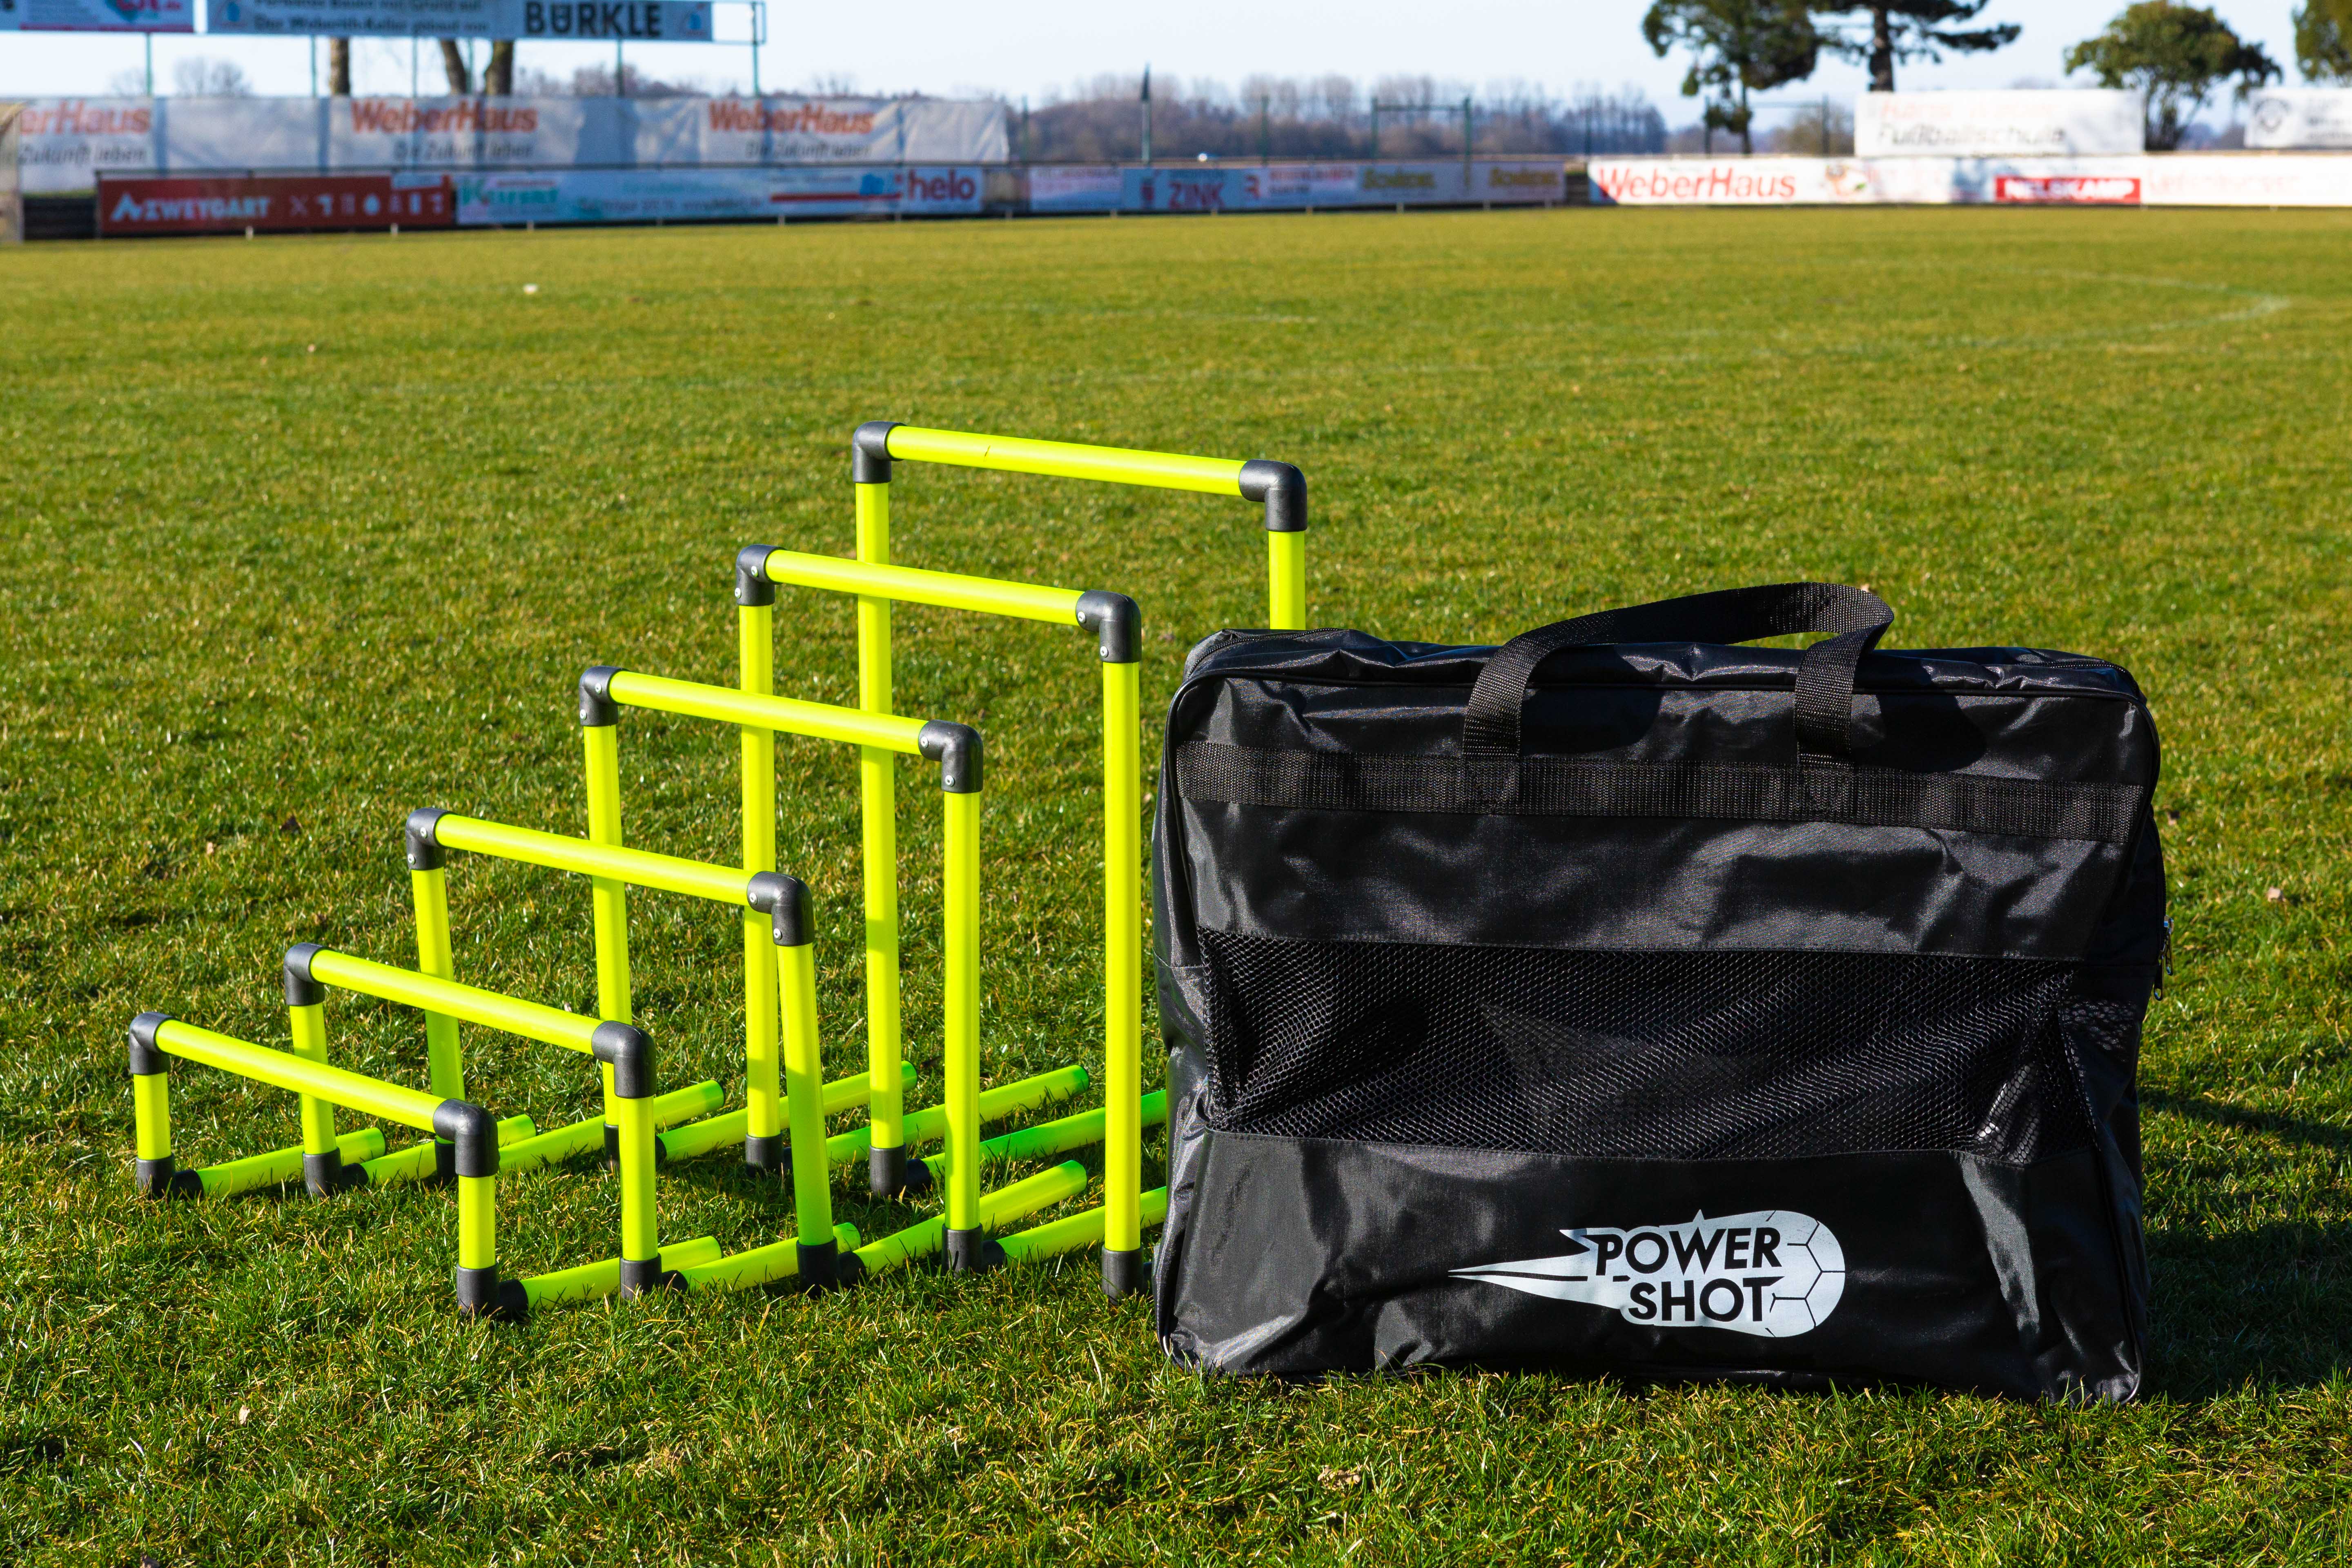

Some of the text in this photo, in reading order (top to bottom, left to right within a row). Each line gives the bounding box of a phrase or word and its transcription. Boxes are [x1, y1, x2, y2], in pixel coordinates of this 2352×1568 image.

[526, 1, 662, 36] BÜRKLE
[351, 99, 538, 134] WeberHaus
[708, 100, 874, 134] WeberHaus
[1167, 182, 1224, 209] ZINK
[1597, 167, 1797, 199] WeberHaus
[1581, 1226, 1782, 1275] POWER
[1628, 1276, 1785, 1322] SHOT
